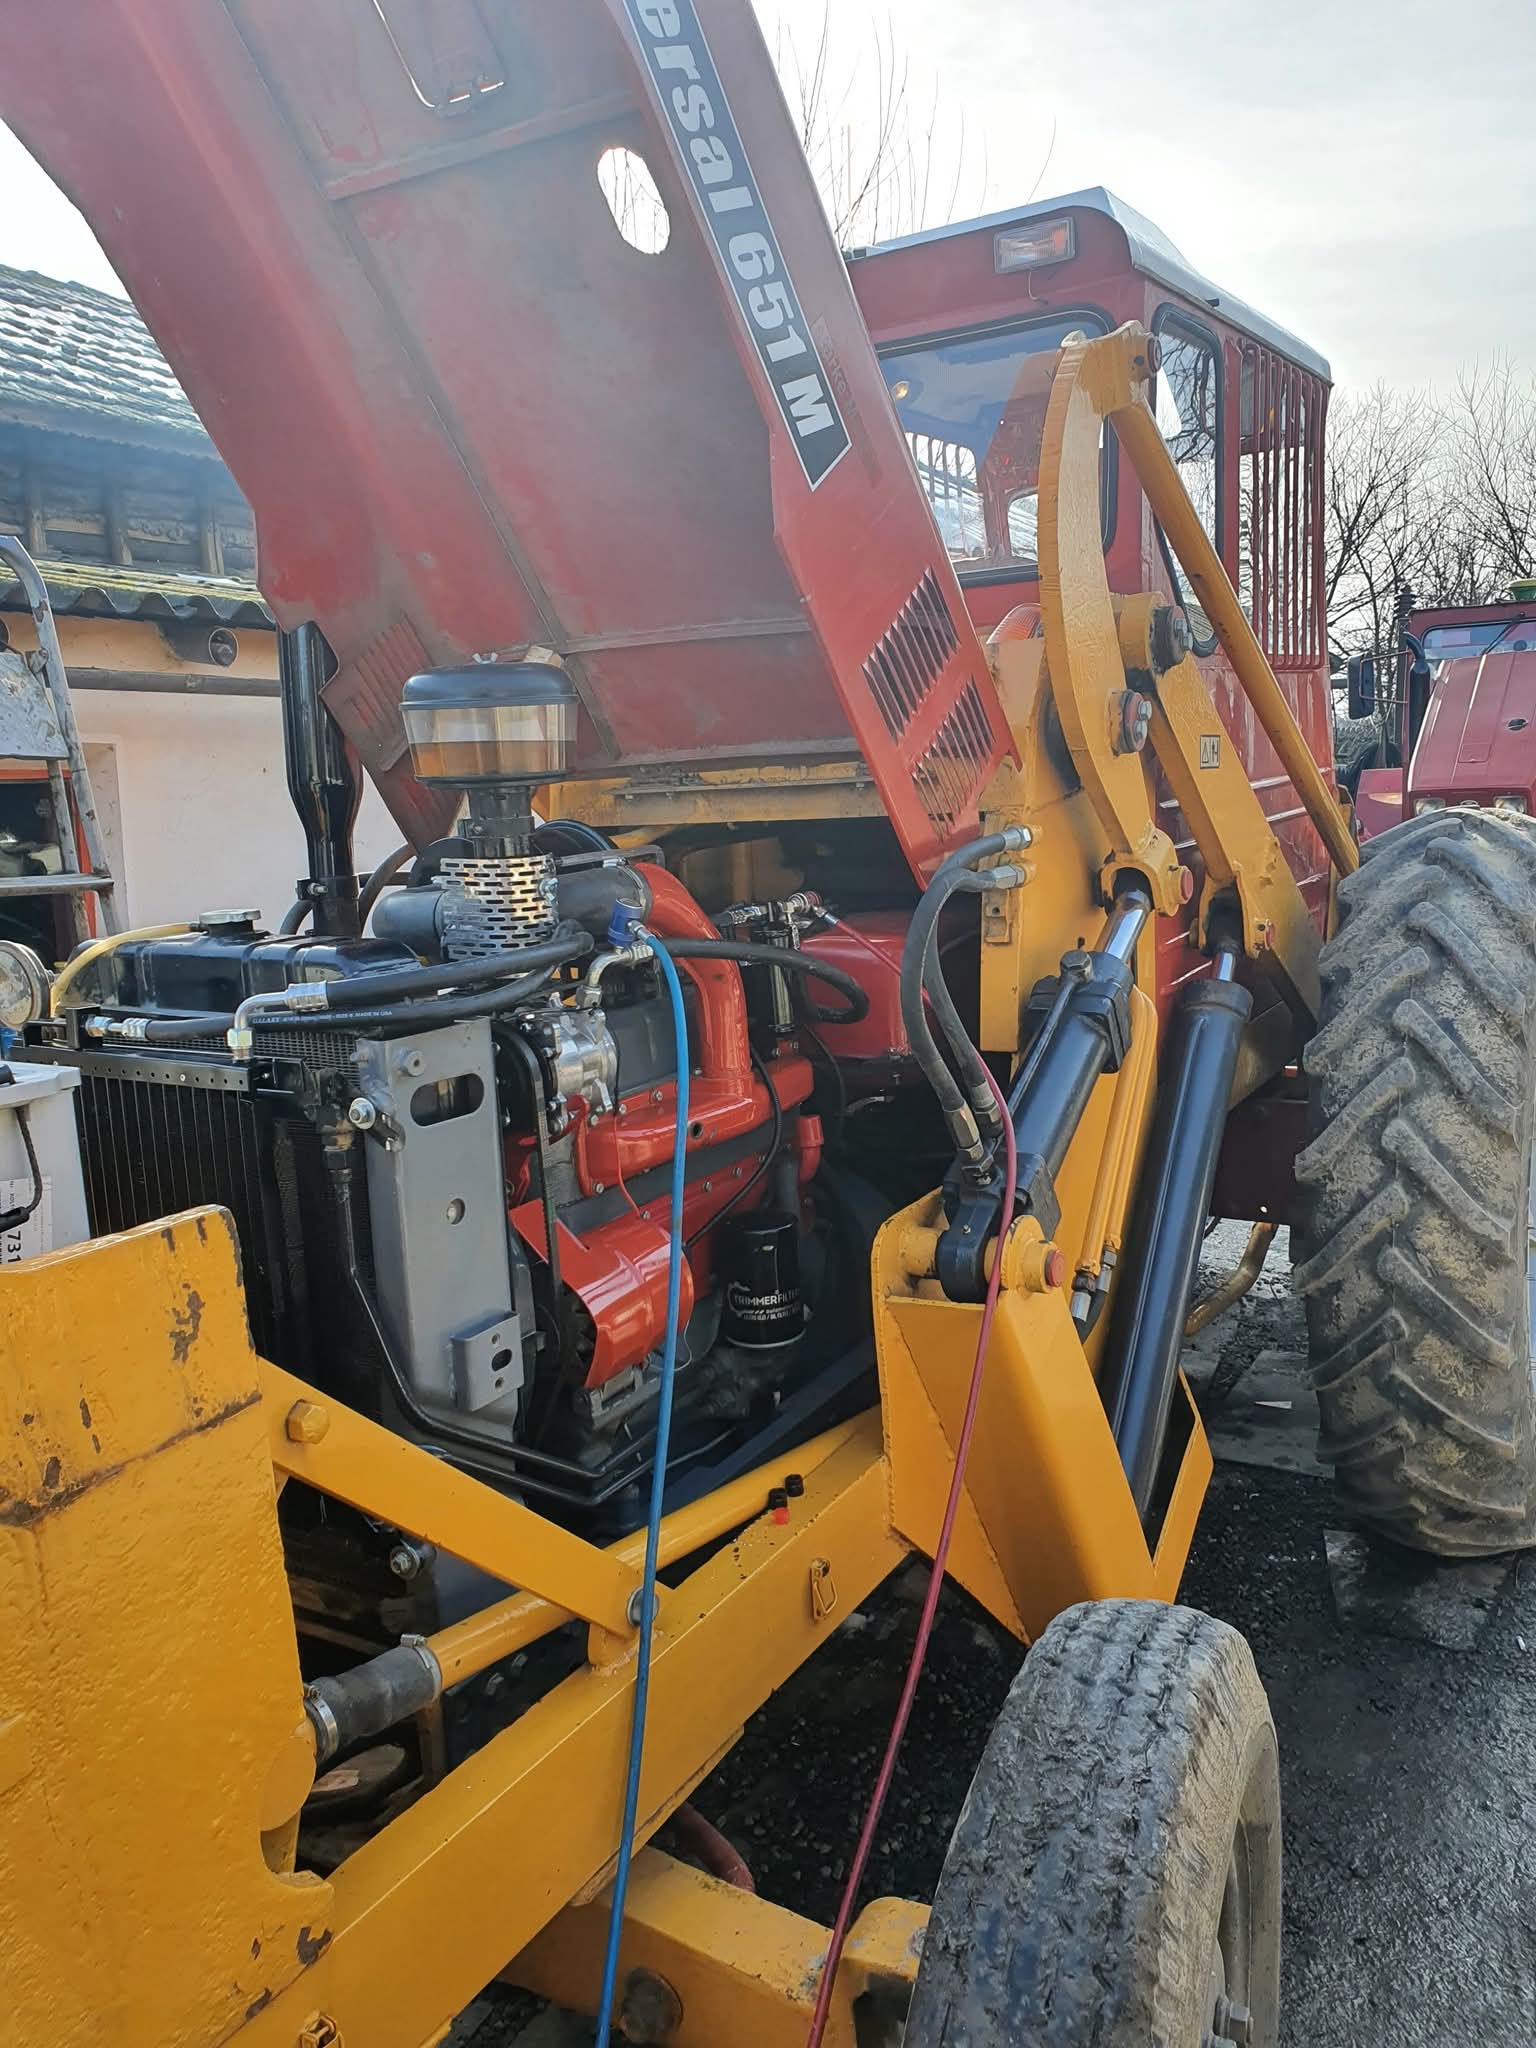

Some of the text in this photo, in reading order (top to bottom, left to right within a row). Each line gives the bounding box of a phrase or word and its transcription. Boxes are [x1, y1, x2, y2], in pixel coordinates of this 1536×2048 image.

[637, 0, 835, 438] ersal 651 M
